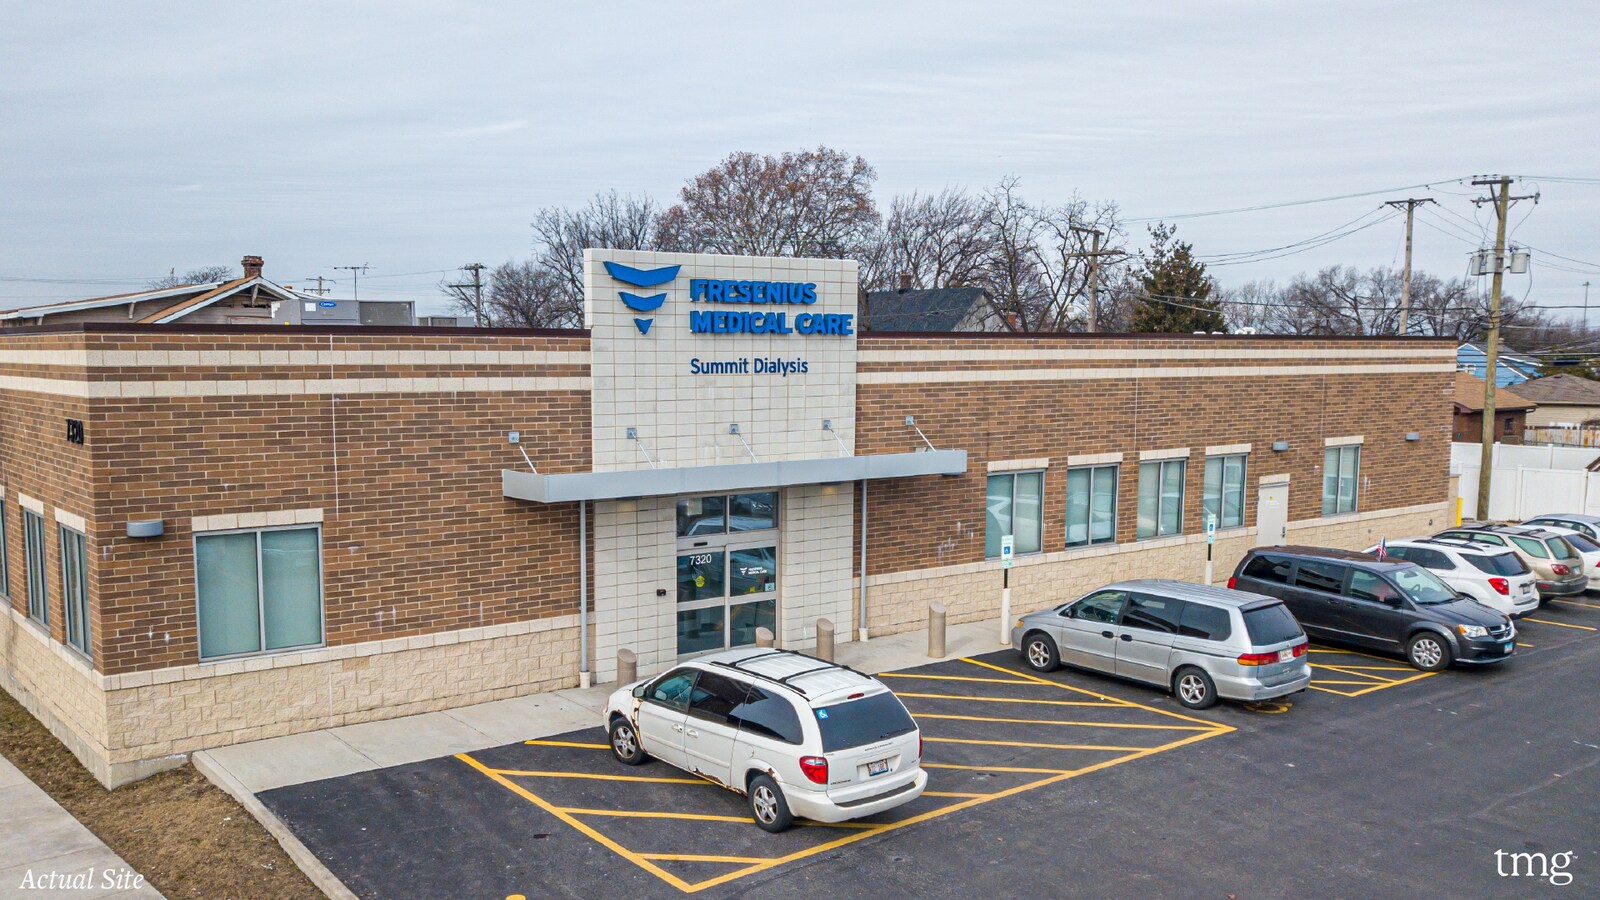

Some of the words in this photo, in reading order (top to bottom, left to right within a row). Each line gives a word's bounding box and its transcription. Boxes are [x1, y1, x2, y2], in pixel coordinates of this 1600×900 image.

[690, 279, 817, 305] FRESENIUS
[690, 311, 792, 335] MEDICAL
[795, 313, 853, 335] CARE
[690, 358, 749, 375] Summit
[753, 358, 808, 378] Dialysis
[689, 554, 712, 565] 7320
